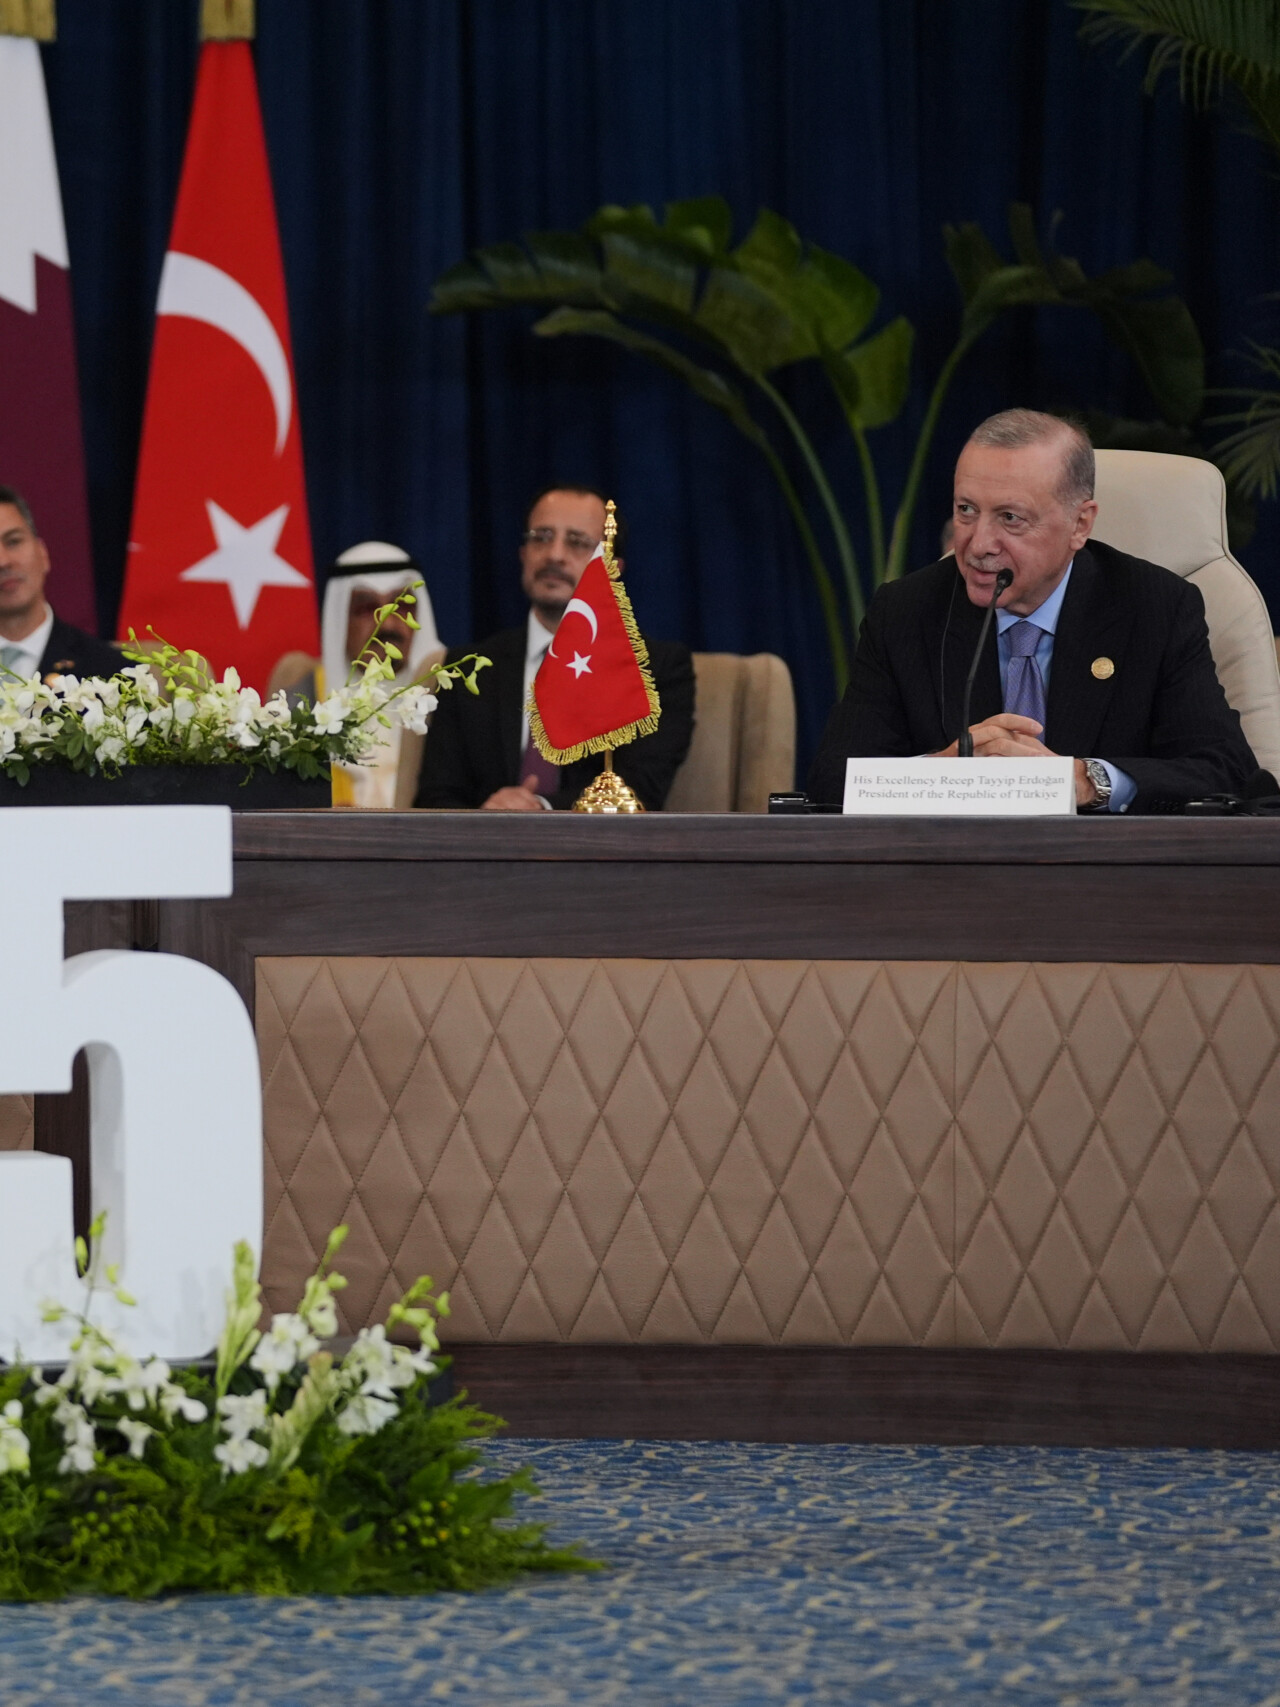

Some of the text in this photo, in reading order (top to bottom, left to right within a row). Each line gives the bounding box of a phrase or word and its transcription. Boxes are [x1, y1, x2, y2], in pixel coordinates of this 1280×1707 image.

[853, 775, 1065, 787] His Excellency Recep Tayyip Erdoğan
[858, 789, 1059, 800] President of the Republic of Türkiye
